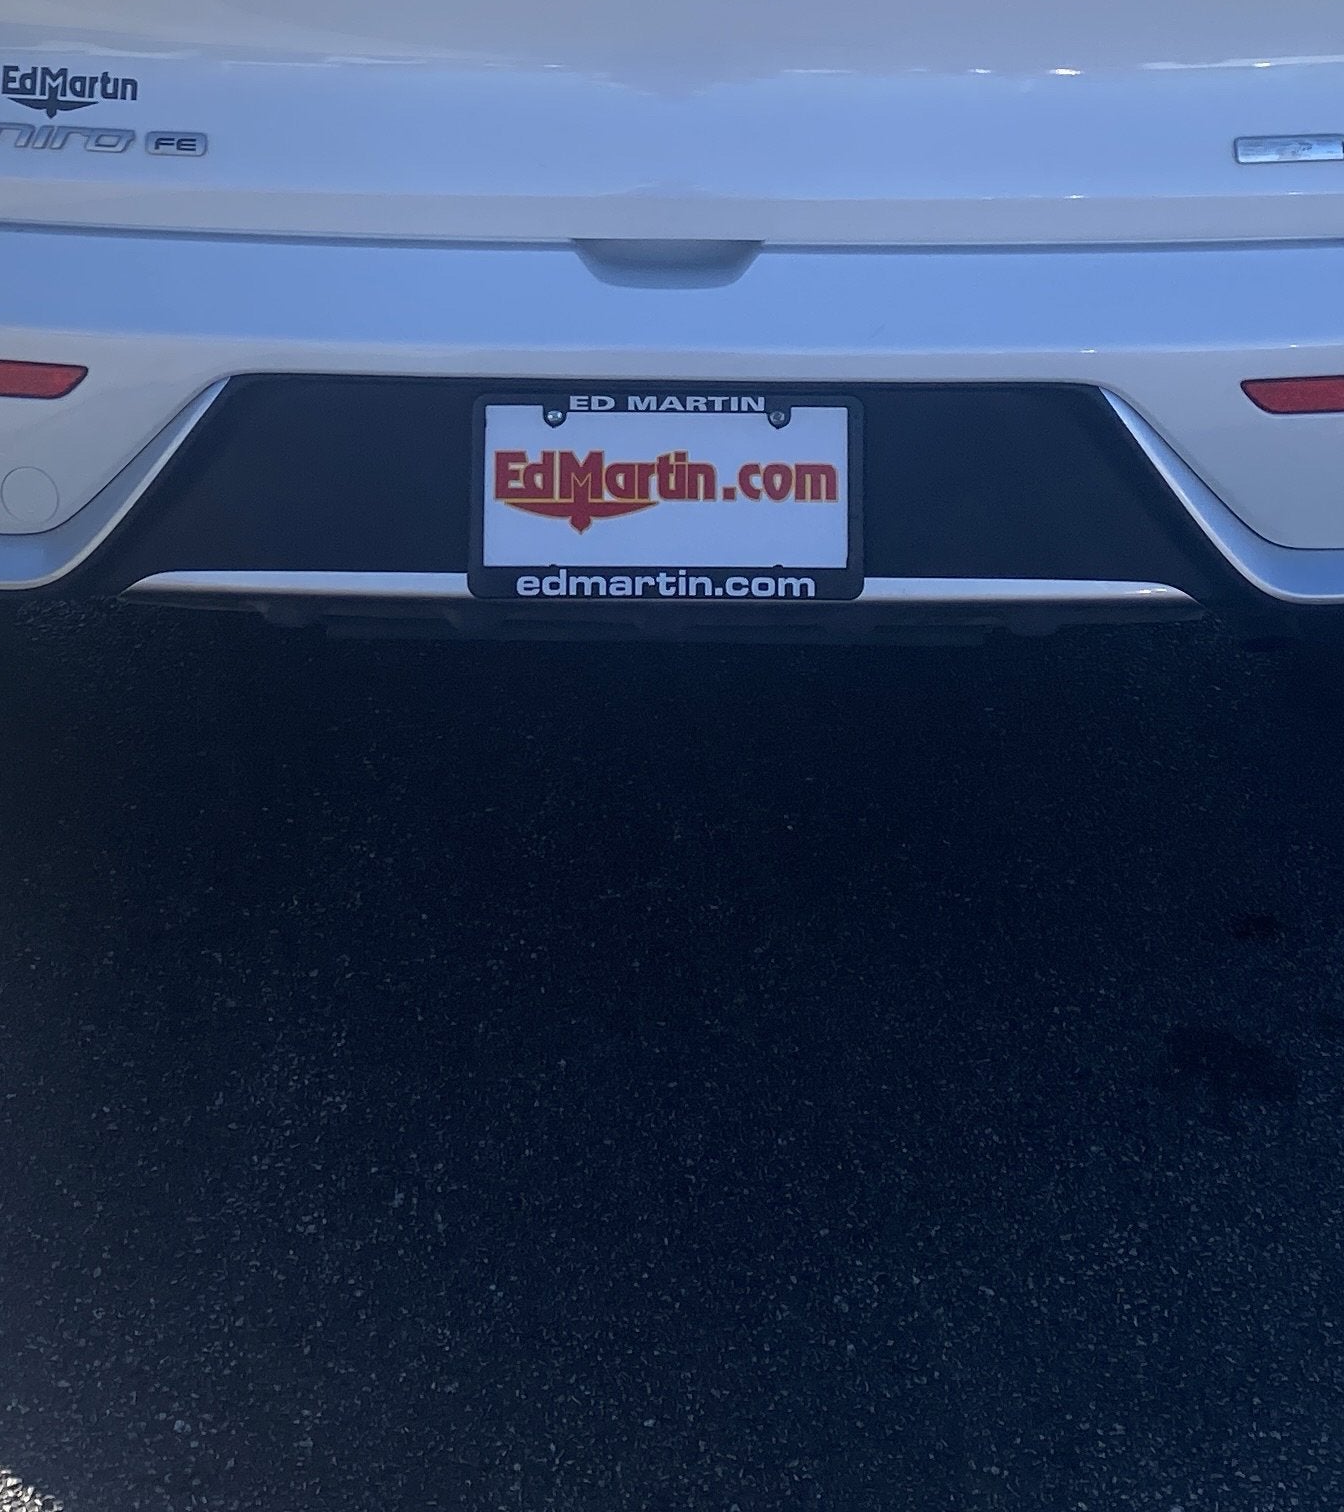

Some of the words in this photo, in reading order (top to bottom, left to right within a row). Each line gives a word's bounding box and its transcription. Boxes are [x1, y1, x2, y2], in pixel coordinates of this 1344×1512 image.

[1, 65, 138, 101] EdMartin
[154, 136, 197, 152] FE
[570, 395, 616, 412] ED
[627, 395, 766, 412] MARTIN
[494, 450, 839, 503] EdMartin.com
[516, 568, 816, 598] edmartin.com
